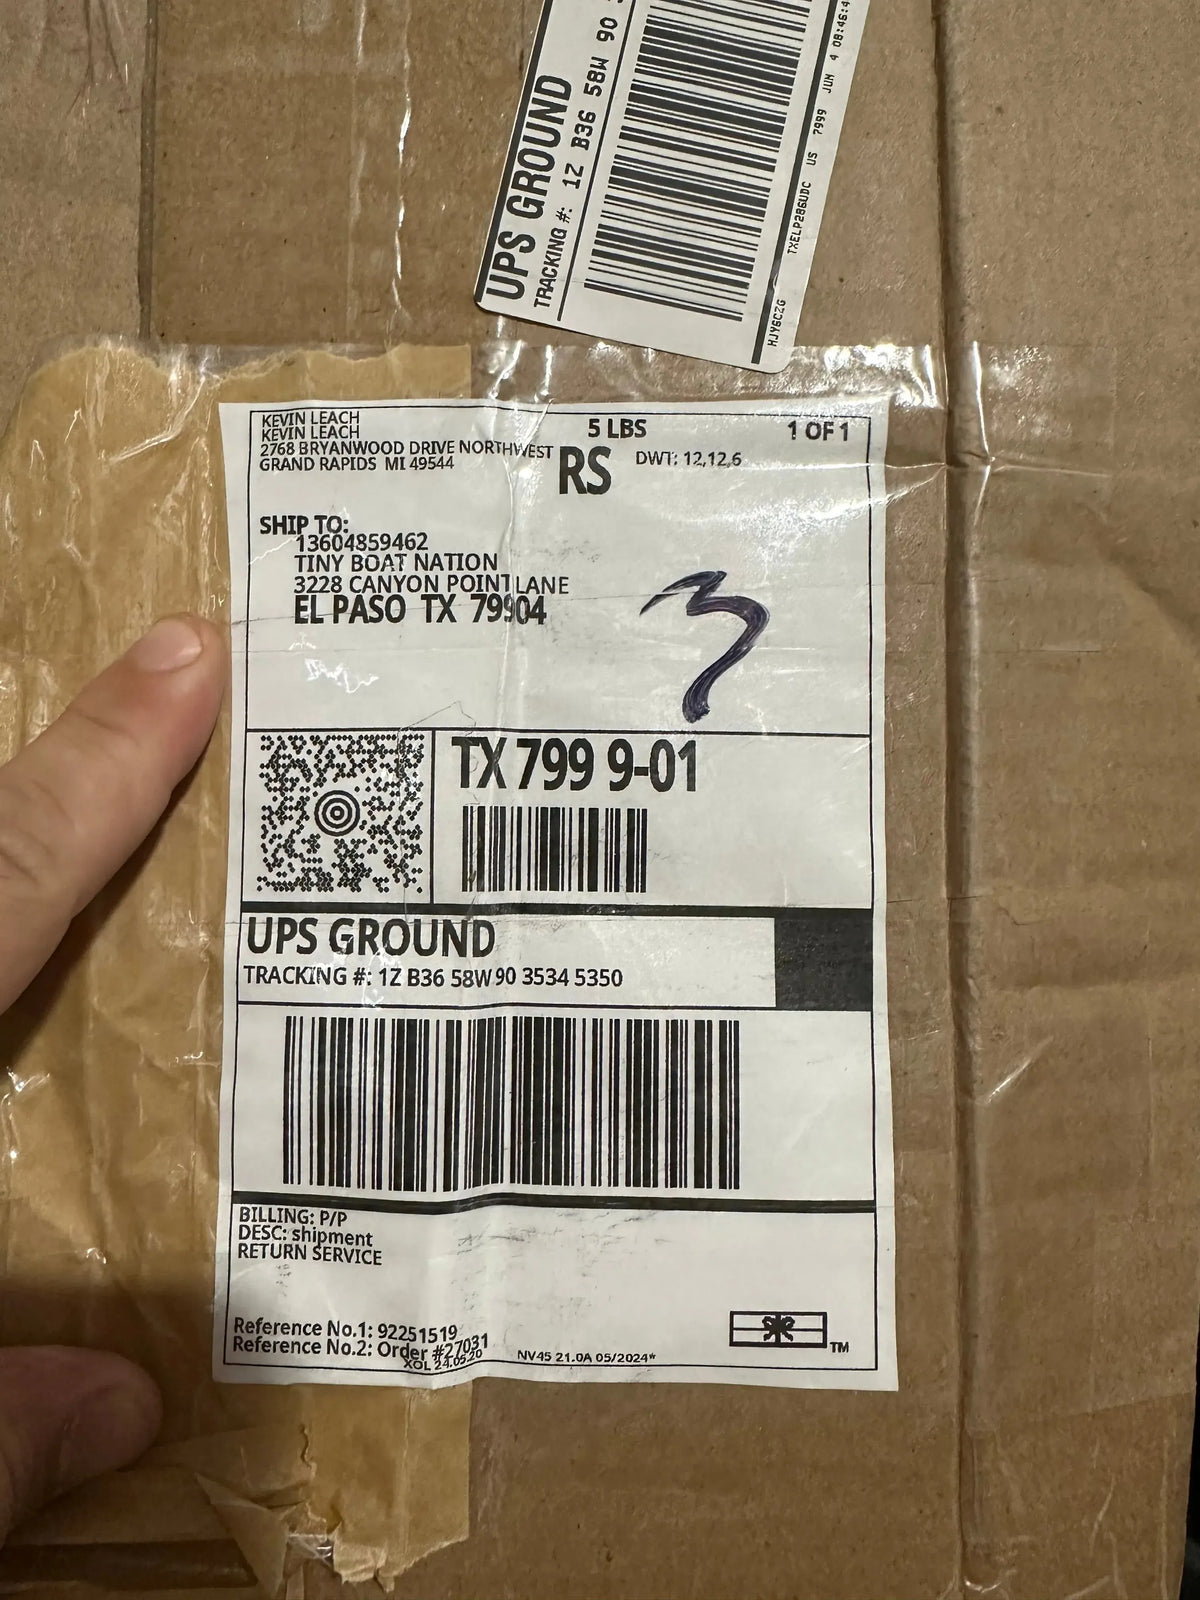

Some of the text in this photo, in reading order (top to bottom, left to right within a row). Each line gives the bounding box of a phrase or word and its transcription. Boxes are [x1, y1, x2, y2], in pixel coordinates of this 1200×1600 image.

[596, 17, 618, 42] 90
[583, 56, 610, 97] 58W
[806, 152, 818, 166] US
[813, 108, 828, 135] 7999
[822, 73, 835, 93] JUN
[571, 110, 596, 151] B36
[563, 164, 584, 189] 1Z
[486, 75, 572, 300] UPS GROUND
[556, 207, 573, 223] #:
[534, 227, 568, 308] TRACKING
[262, 411, 360, 428] KEVIN LEACH
[588, 418, 647, 439] 5 LBS
[262, 425, 360, 442] KEVIN LEACH
[787, 421, 849, 442] 1 OF 1
[260, 440, 554, 459] 2768 BRYANWOOD DRIVE NORTHWEST
[636, 450, 742, 468] DWT: 12,12,6
[259, 455, 455, 472] GRAND RAPIDS MI 49544
[559, 446, 612, 495] RS
[259, 515, 349, 535] SHIP TO:
[296, 532, 429, 552] 13604859462
[294, 552, 498, 573] TINY BOAT NATION
[293, 574, 569, 594] 3228 CANYON POINT LANE
[294, 593, 547, 625] EL PASO TX 79904
[452, 736, 698, 793] TX 799 9-01
[246, 916, 496, 958] UPS GROUND
[243, 964, 623, 989] TRACKING #: 1Z B36 58W 90 3534 5350
[239, 1206, 348, 1227] BILLING: P/P
[238, 1225, 374, 1247] DESC: shipment
[237, 1243, 382, 1266] RETURN SERVICE
[234, 1317, 458, 1344] Reference No.1: 92251519
[233, 1332, 488, 1361] Reference No.2: Order #27031
[517, 1349, 552, 1362] NV45
[555, 1351, 593, 1363] 21.0A
[830, 1341, 850, 1354] TM
[403, 1358, 431, 1371] XOL
